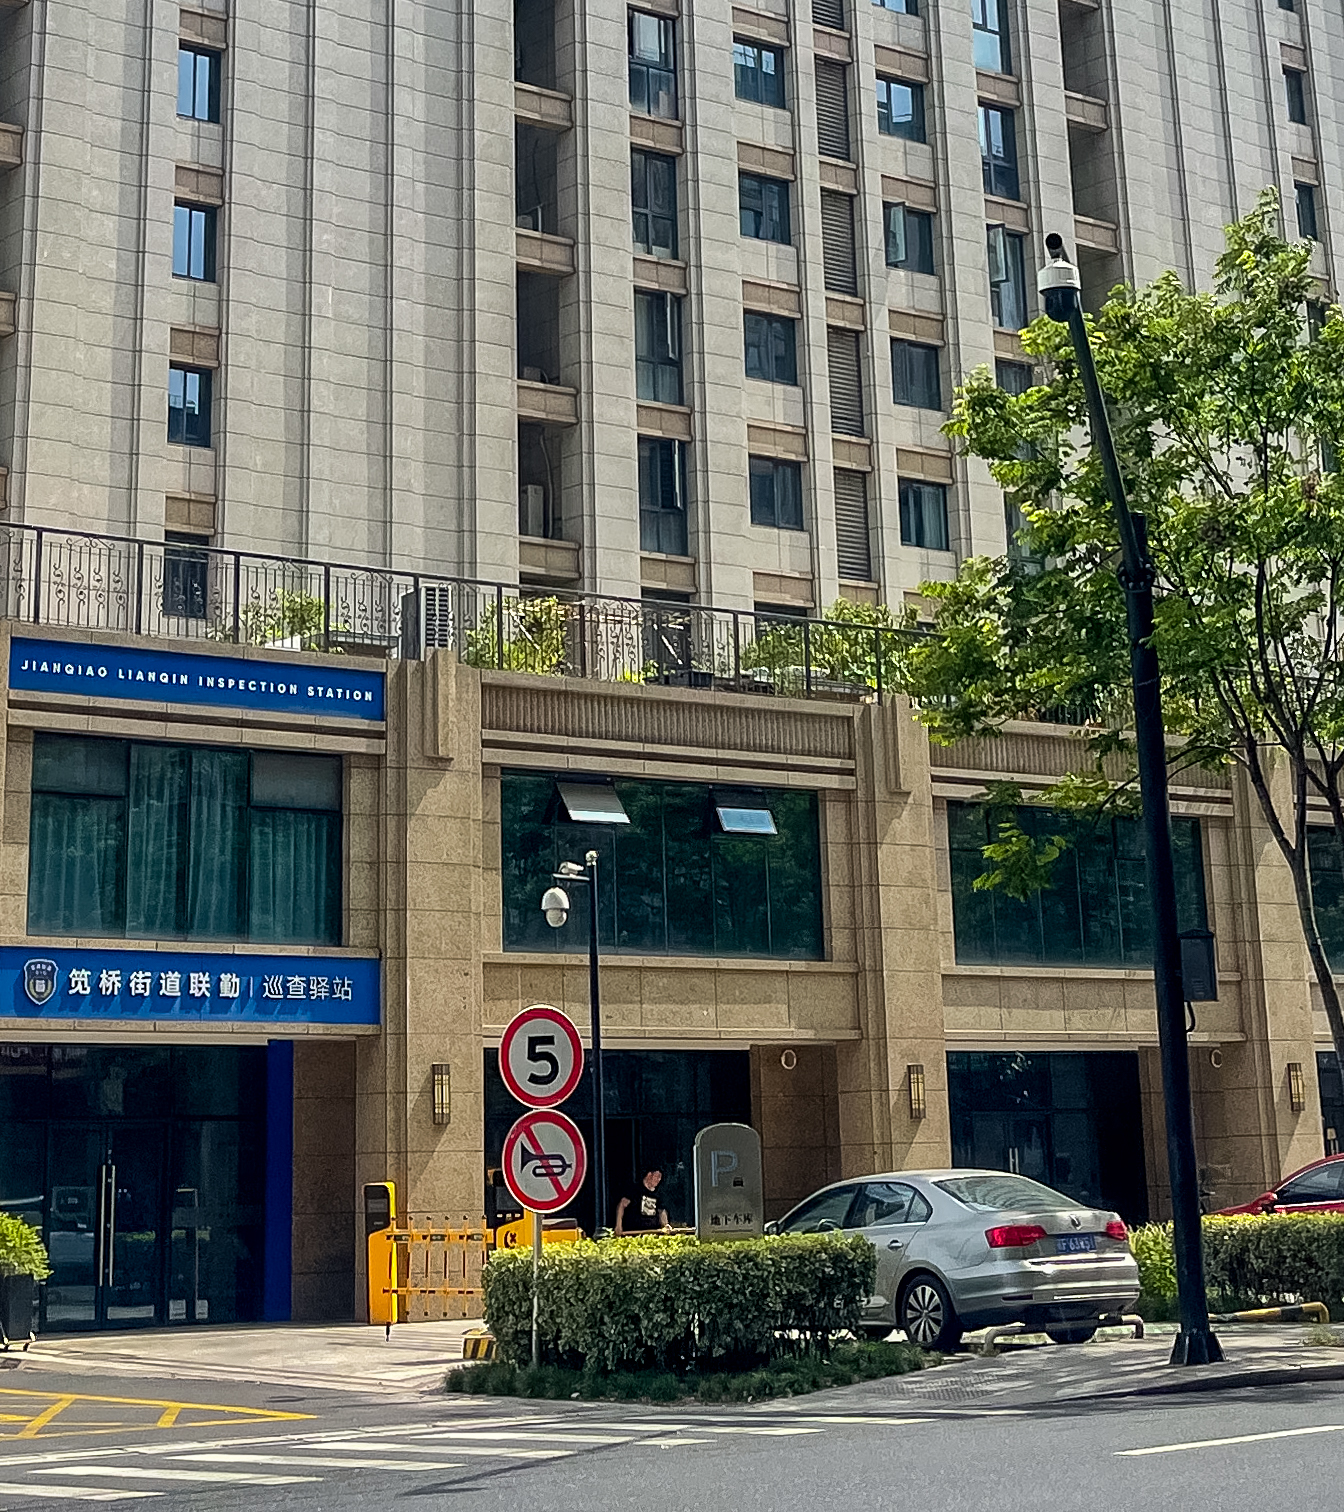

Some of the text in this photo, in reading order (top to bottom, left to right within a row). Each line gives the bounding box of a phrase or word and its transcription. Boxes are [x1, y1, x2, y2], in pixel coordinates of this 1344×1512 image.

[21, 659, 373, 702] JIANQIAO LIANQIN INSPECTION STATION
[68, 969, 241, 998] 笕桥街道联勤
[262, 974, 353, 1001] 巡查驿站
[526, 1034, 560, 1086] 5
[711, 1150, 738, 1187] P
